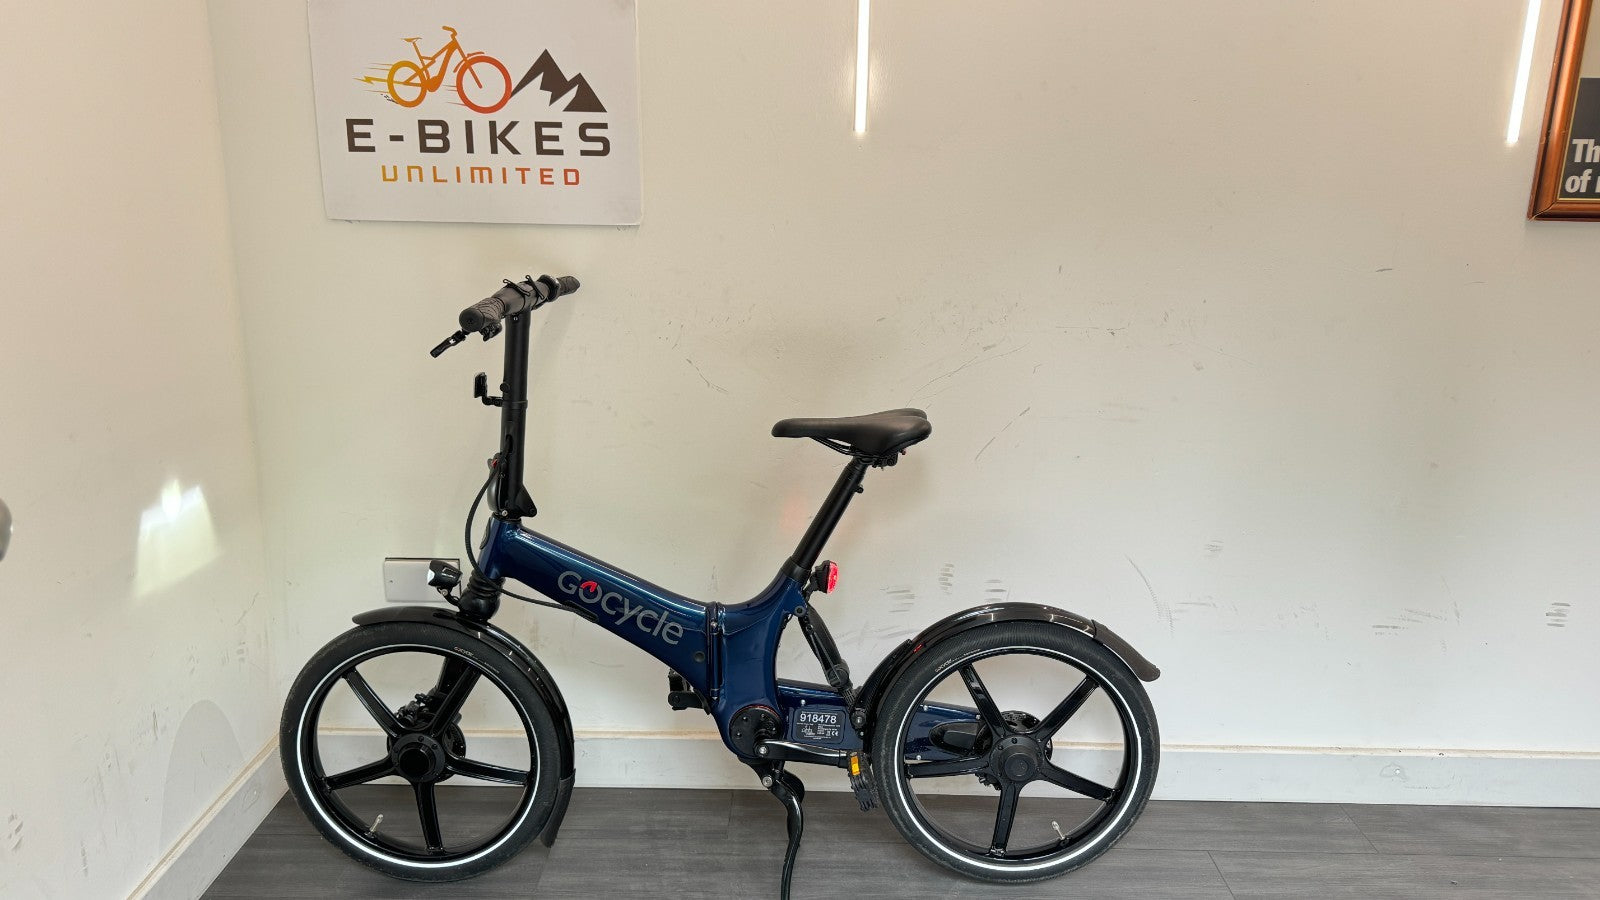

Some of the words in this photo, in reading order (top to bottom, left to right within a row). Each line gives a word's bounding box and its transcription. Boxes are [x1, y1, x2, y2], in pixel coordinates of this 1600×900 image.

[346, 118, 611, 156] E-BIKES
[381, 165, 580, 185] UNLIMITED
[1565, 168, 1593, 193] of
[800, 713, 837, 724] 918478
